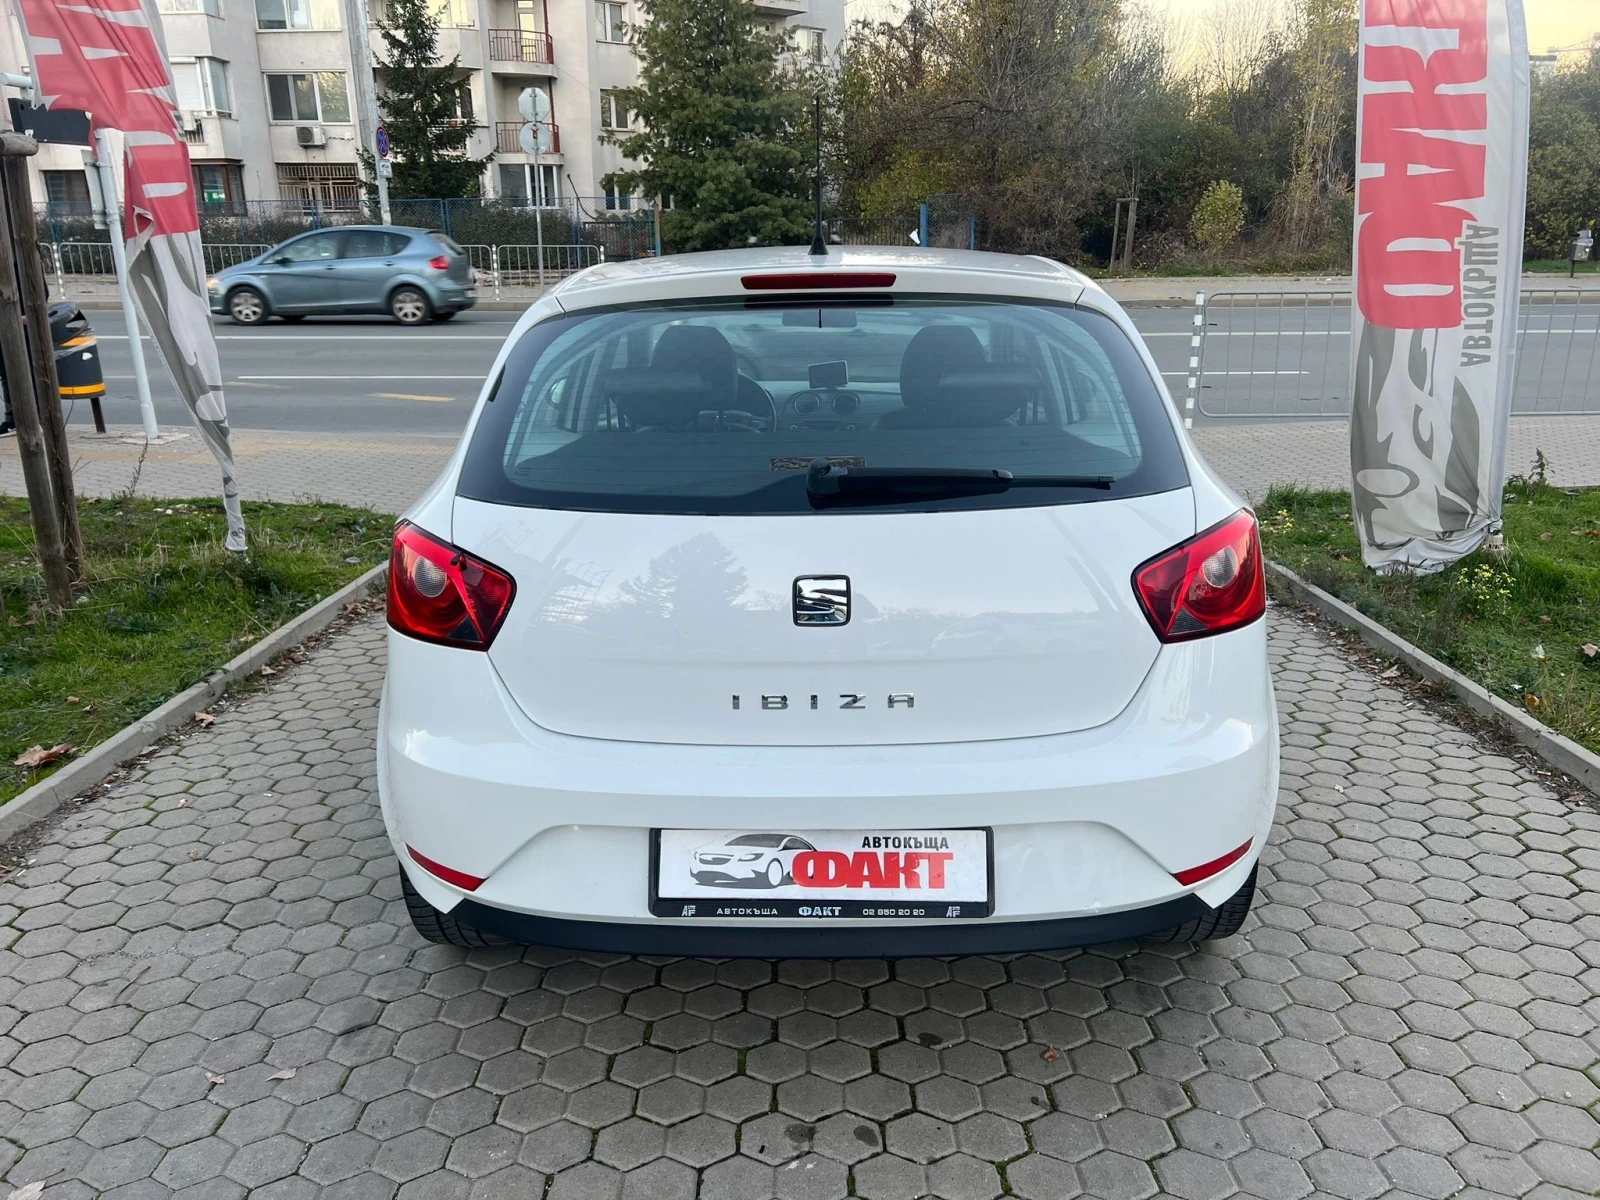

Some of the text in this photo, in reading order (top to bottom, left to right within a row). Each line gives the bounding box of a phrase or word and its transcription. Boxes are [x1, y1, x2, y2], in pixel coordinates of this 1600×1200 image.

[732, 692, 916, 710] IBIZA
[862, 836, 950, 851] АВТОКЪЩА
[791, 851, 954, 889] ФАКТ
[798, 906, 842, 916] ФАКТ
